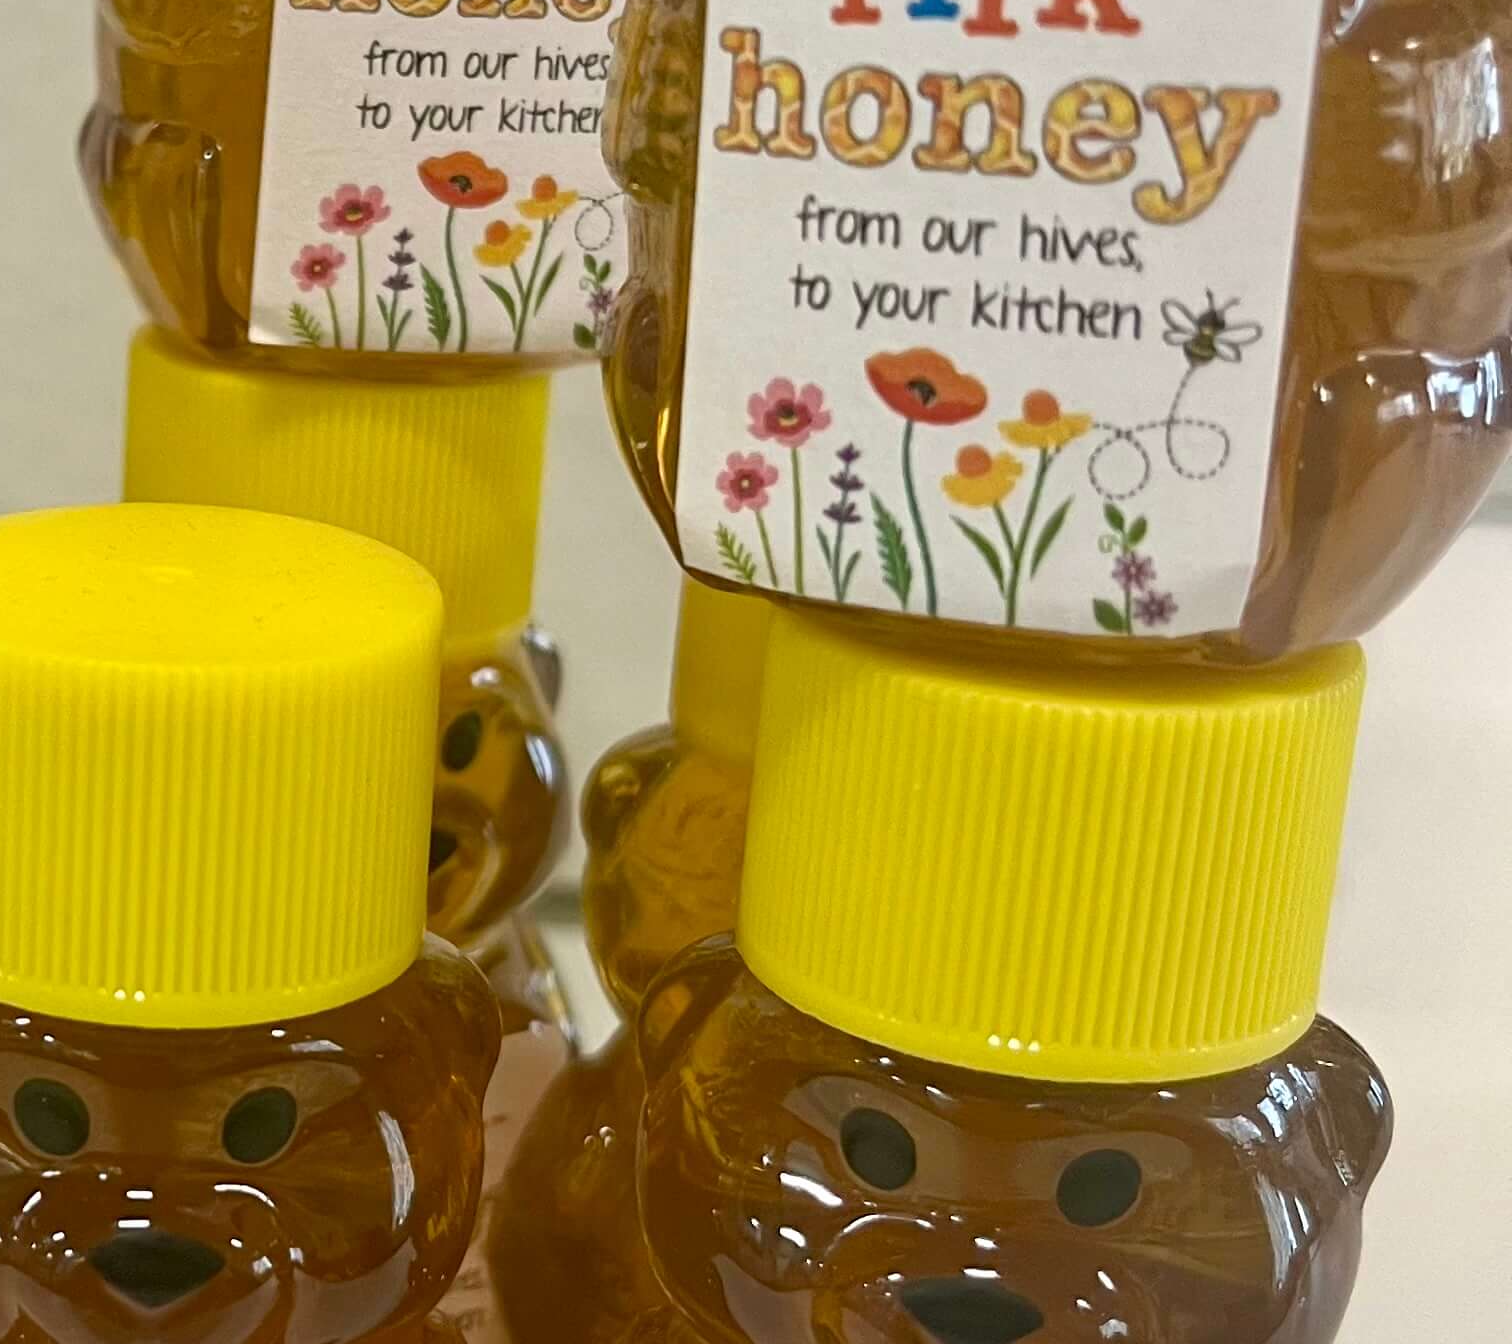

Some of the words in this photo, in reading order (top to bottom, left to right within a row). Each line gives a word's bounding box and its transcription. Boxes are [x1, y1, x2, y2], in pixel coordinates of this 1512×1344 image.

[363, 40, 447, 78] from
[464, 52, 518, 80] our
[356, 93, 390, 129] to
[410, 103, 484, 141] your
[714, 26, 1281, 225] honey
[796, 196, 900, 249] from
[923, 216, 996, 256] our
[1020, 213, 1143, 272] hives,
[789, 265, 831, 310] to
[853, 279, 951, 331] your
[972, 281, 1142, 340] kitchen
